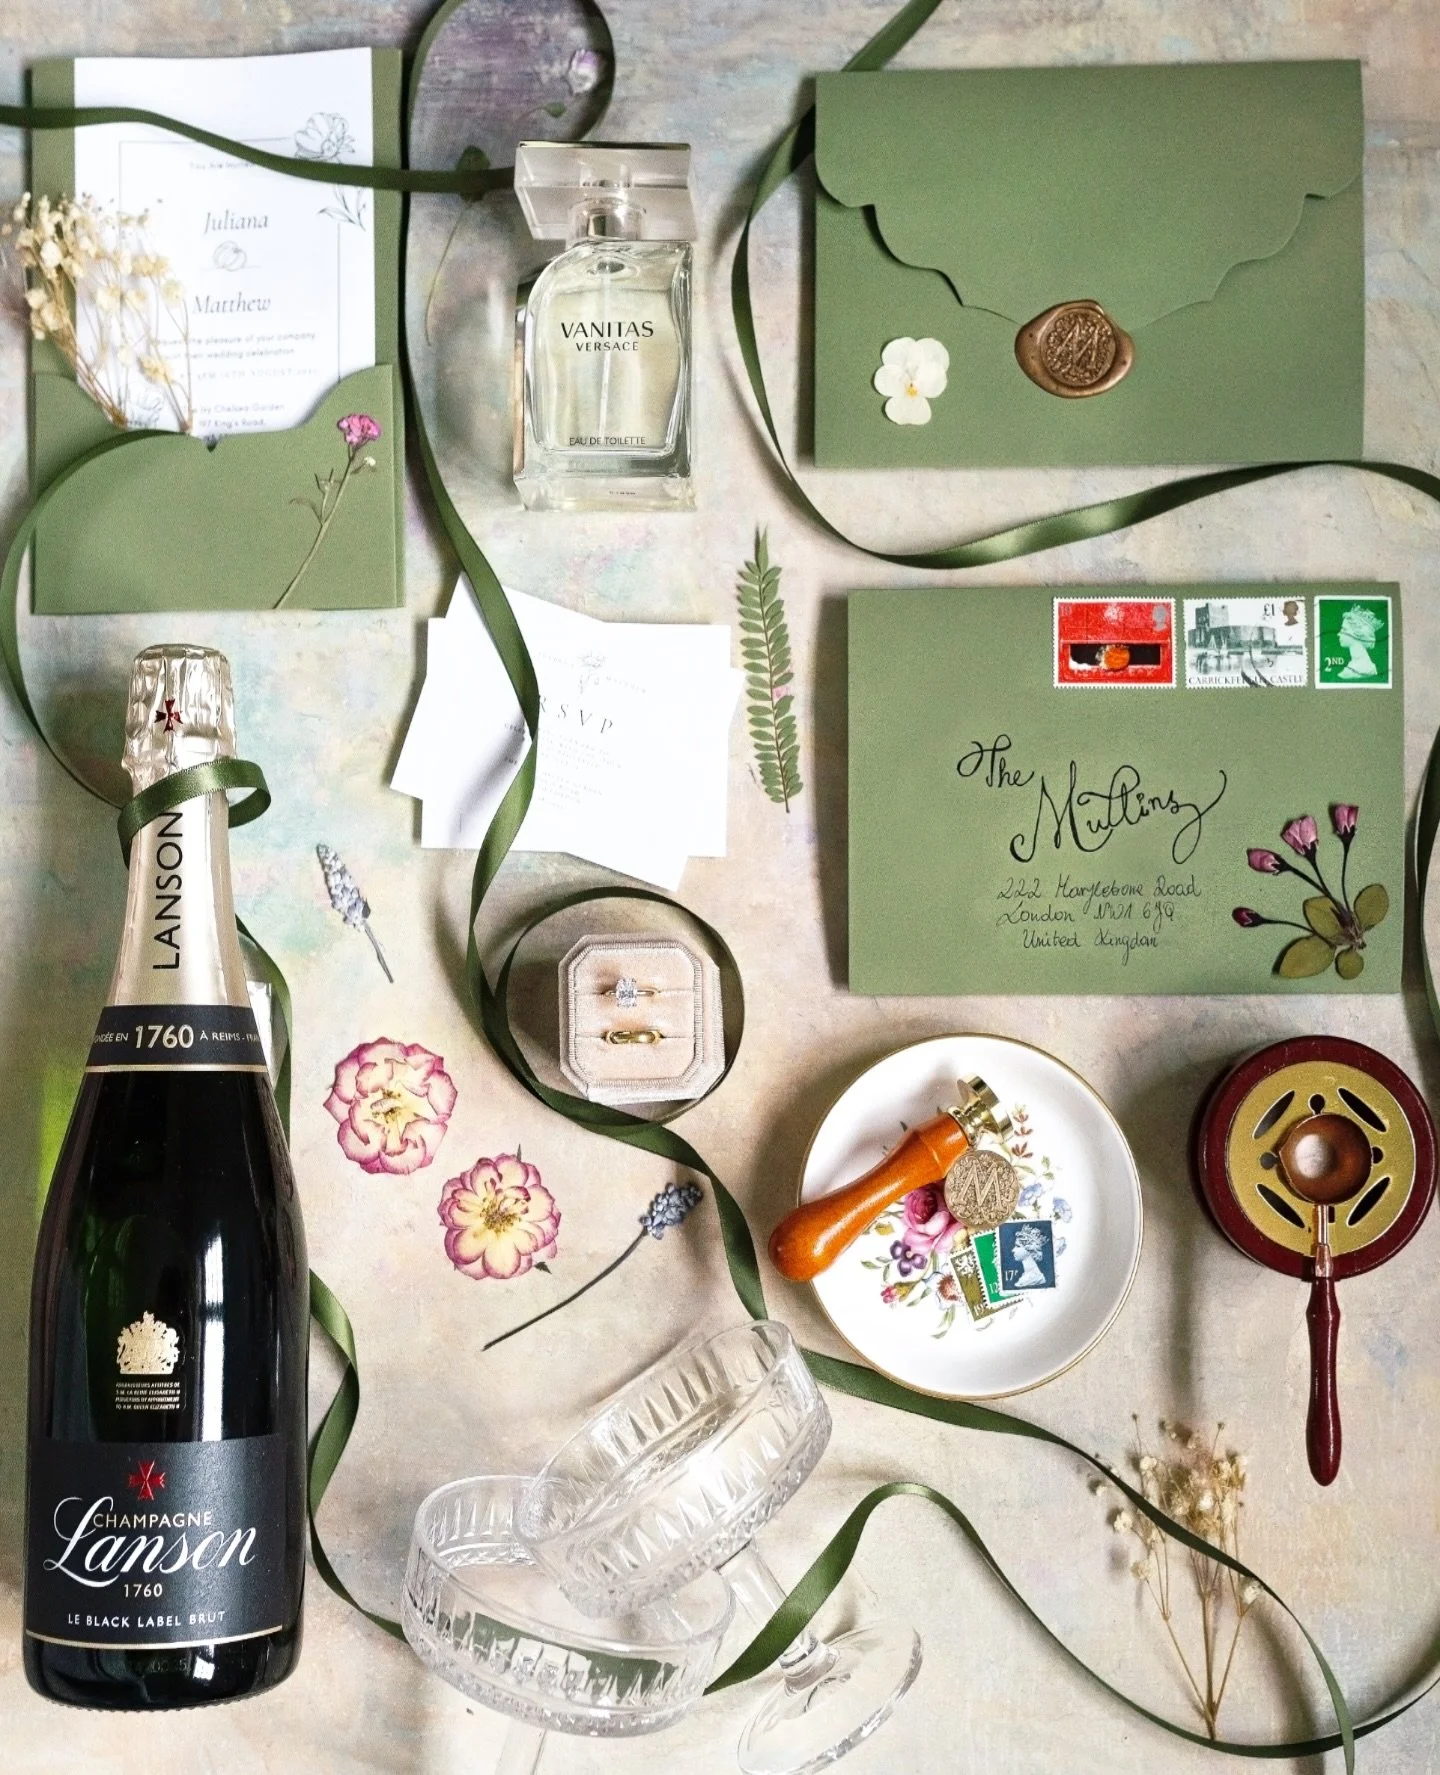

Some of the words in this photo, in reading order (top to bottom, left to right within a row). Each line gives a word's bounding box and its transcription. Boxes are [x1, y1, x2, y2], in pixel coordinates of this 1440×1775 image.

[203, 209, 269, 235] Juliana
[192, 291, 271, 314] Matthew
[561, 320, 654, 339] VANITAS
[576, 341, 639, 352] VERSACE
[569, 436, 587, 446] EAU
[589, 436, 602, 445] DE
[605, 436, 646, 445] TOILETTE
[1263, 603, 1275, 617] £1
[957, 734, 1035, 788] The
[152, 811, 184, 971] LANSON
[996, 876, 1042, 900] 222
[1153, 874, 1201, 898] Road
[995, 900, 1075, 928] London
[1022, 929, 1081, 949] United
[115, 1032, 129, 1043] EN
[135, 1025, 194, 1050] 1760
[211, 1031, 241, 1042] REIMS
[93, 1511, 213, 1529] CHAMPAGNE
[43, 1496, 257, 1588] Lanson
[124, 1583, 163, 1598] 1760
[68, 1613, 80, 1625] LE
[86, 1614, 130, 1628] BLACK
[137, 1614, 182, 1627] LABEL
[189, 1611, 226, 1626] BRUT
